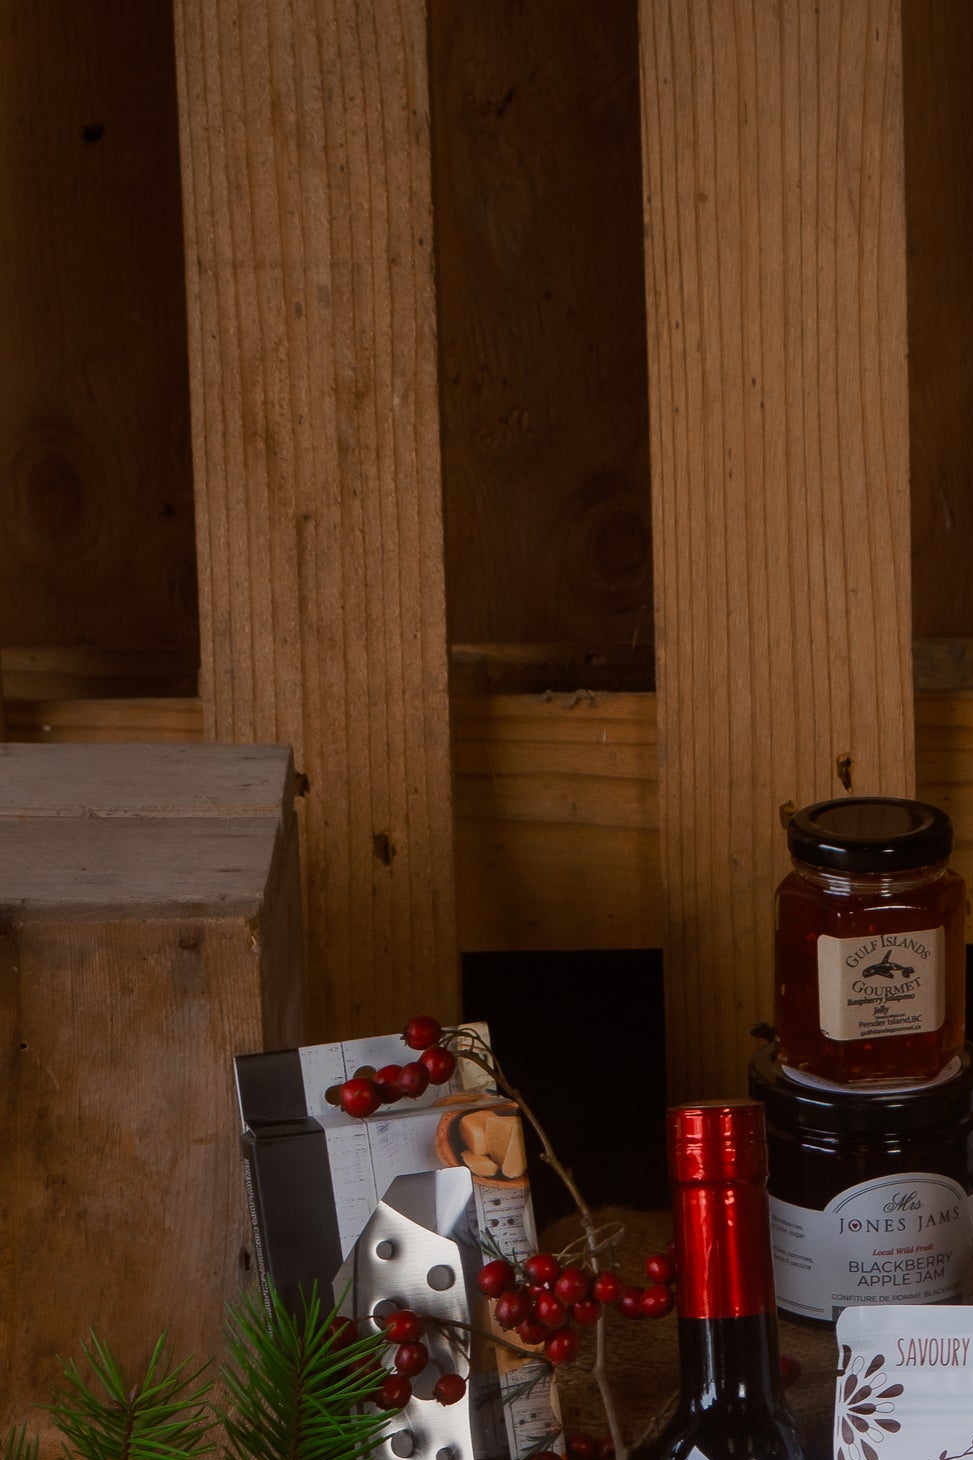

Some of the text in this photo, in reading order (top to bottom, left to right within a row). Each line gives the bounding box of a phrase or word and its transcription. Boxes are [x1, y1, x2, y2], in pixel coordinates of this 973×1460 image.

[846, 935, 931, 968] GULF ISLANDS
[852, 977, 922, 997] GOURMET
[882, 1191, 924, 1214] Mrs
[839, 1206, 960, 1235] JONES JAMS
[848, 1250, 953, 1273] BLACKBERRY
[857, 1266, 945, 1287] APPLE JAM
[831, 1293, 877, 1303] CONFITURE
[896, 1338, 970, 1368] SAVOURY
